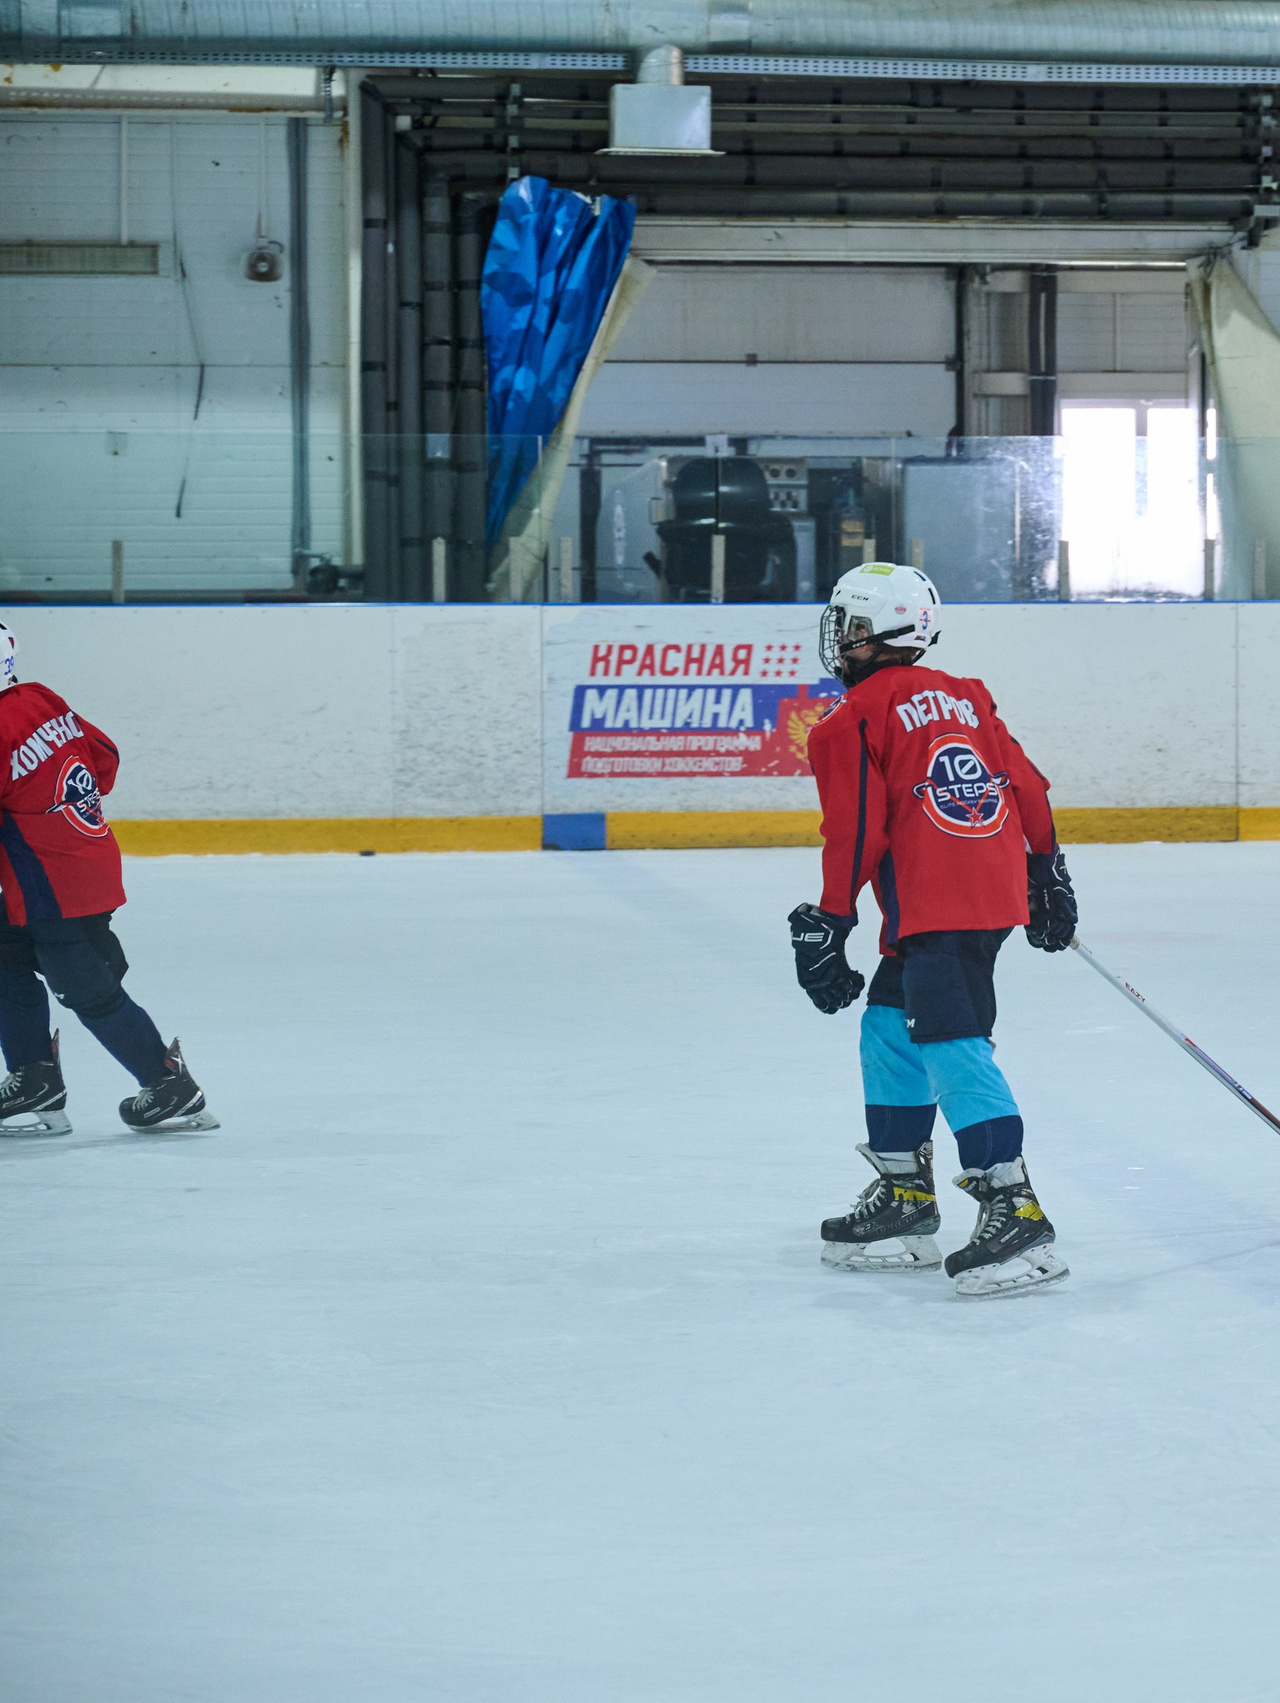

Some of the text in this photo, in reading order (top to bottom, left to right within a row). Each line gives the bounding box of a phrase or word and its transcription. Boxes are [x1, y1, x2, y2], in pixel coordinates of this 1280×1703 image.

[851, 594, 870, 602] CCM
[589, 643, 754, 677] КРАСНАЯ
[580, 687, 755, 729] МАШИНА
[896, 689, 980, 733] ПЕТРОВ
[939, 754, 982, 782] 10
[936, 782, 998, 802] STEPS
